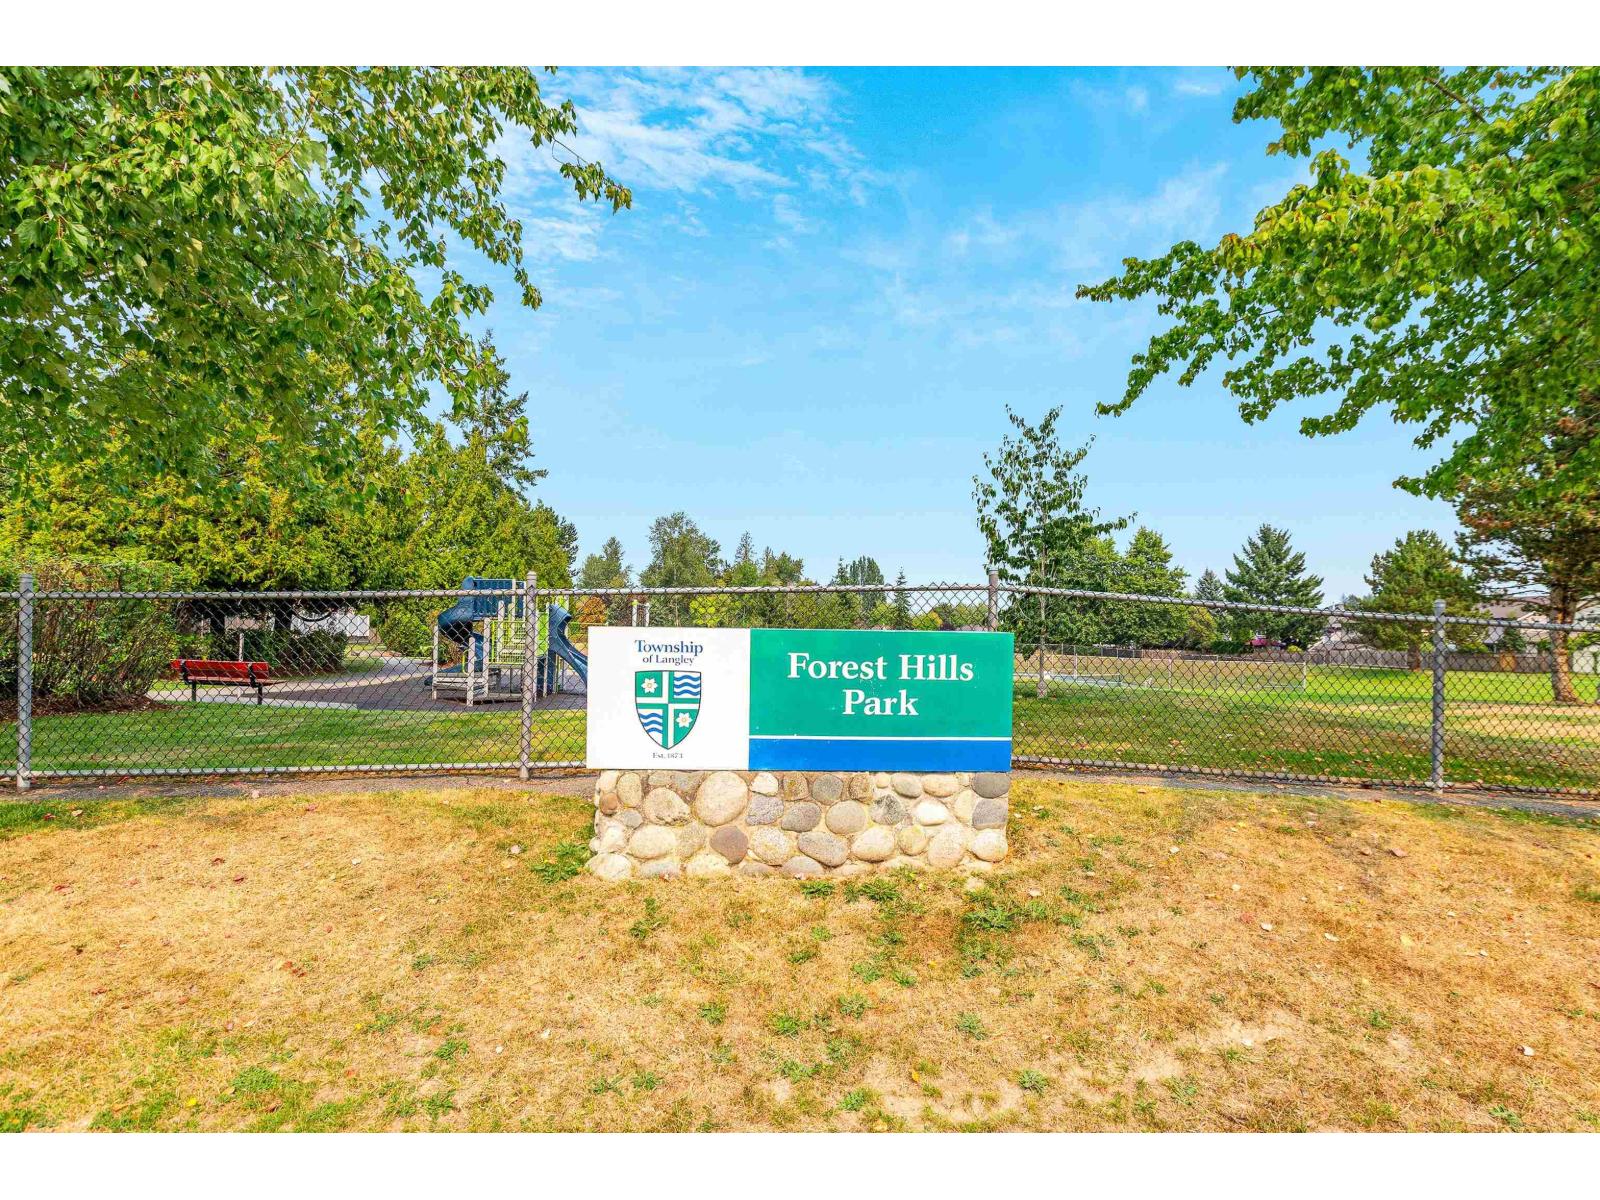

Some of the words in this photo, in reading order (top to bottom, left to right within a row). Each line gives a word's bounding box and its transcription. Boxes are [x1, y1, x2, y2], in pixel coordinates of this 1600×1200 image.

[634, 639, 704, 656] Township
[642, 654, 653, 663] of
[655, 655, 695, 666] Langley
[787, 652, 888, 680] Forest
[898, 654, 974, 681] Hills
[842, 689, 919, 716] Park
